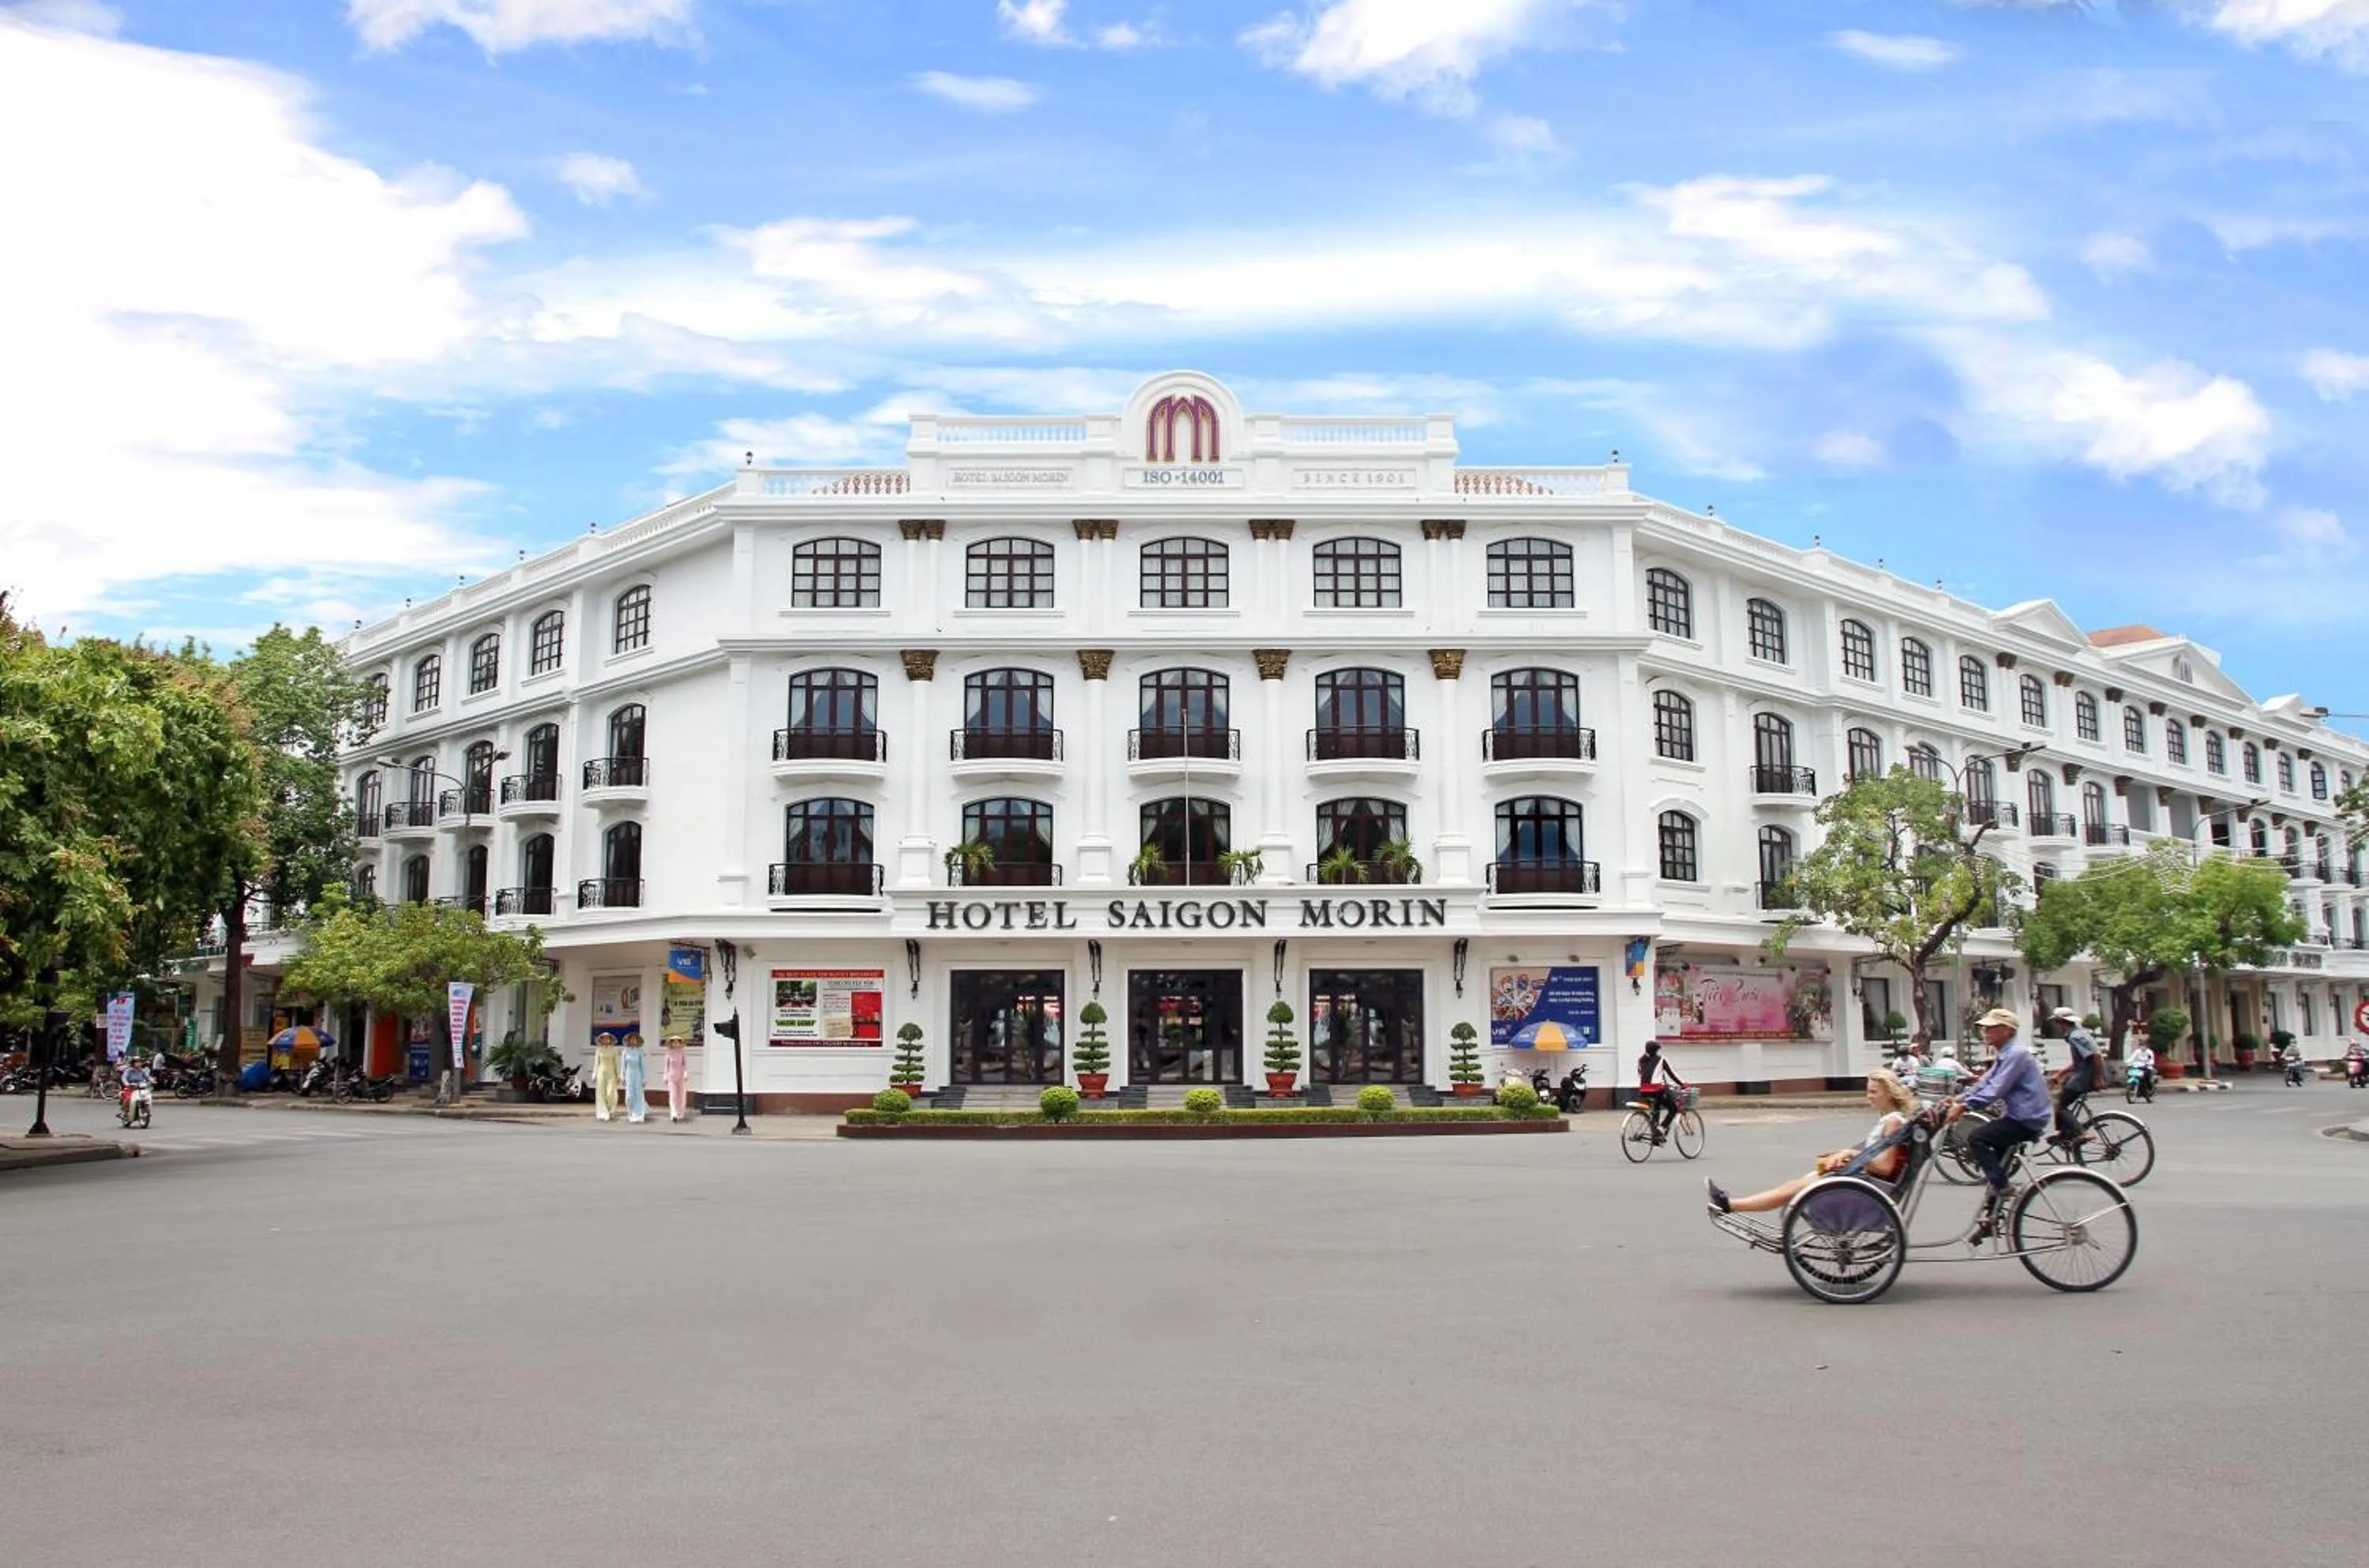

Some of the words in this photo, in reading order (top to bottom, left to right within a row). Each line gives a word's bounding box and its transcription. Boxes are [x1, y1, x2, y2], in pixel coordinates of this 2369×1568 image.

[925, 901, 1077, 930] HOTEL
[1108, 899, 1268, 929] SAIGON
[1299, 898, 1447, 928] MORIN
